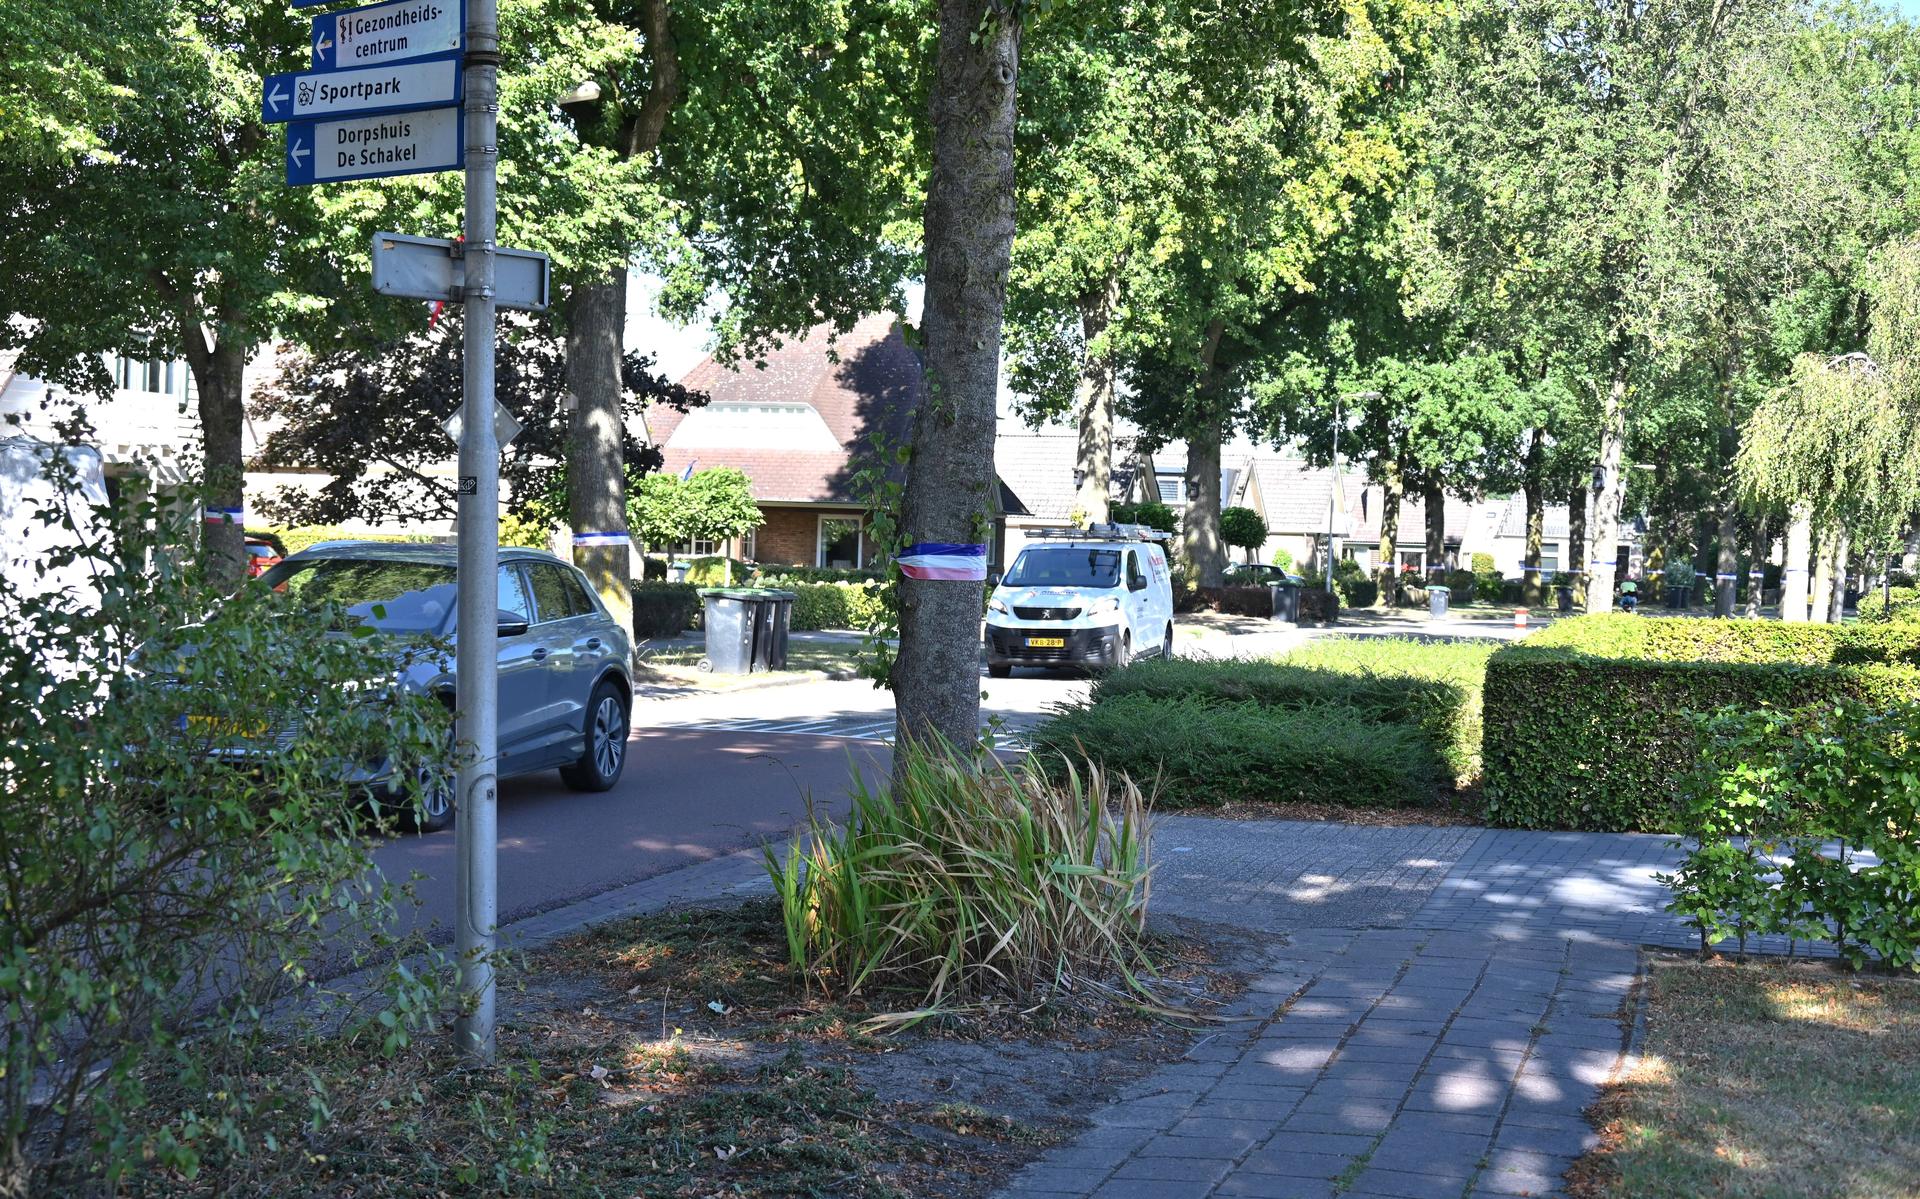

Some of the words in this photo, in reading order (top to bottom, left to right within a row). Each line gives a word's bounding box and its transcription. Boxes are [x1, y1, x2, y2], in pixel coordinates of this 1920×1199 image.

[355, 5, 443, 35] Gezondheids-
[355, 34, 408, 58] centrum
[320, 77, 401, 103] Sportpark
[337, 121, 411, 145] Dorpshuis
[337, 151, 356, 168] De
[360, 144, 416, 166] Schakel
